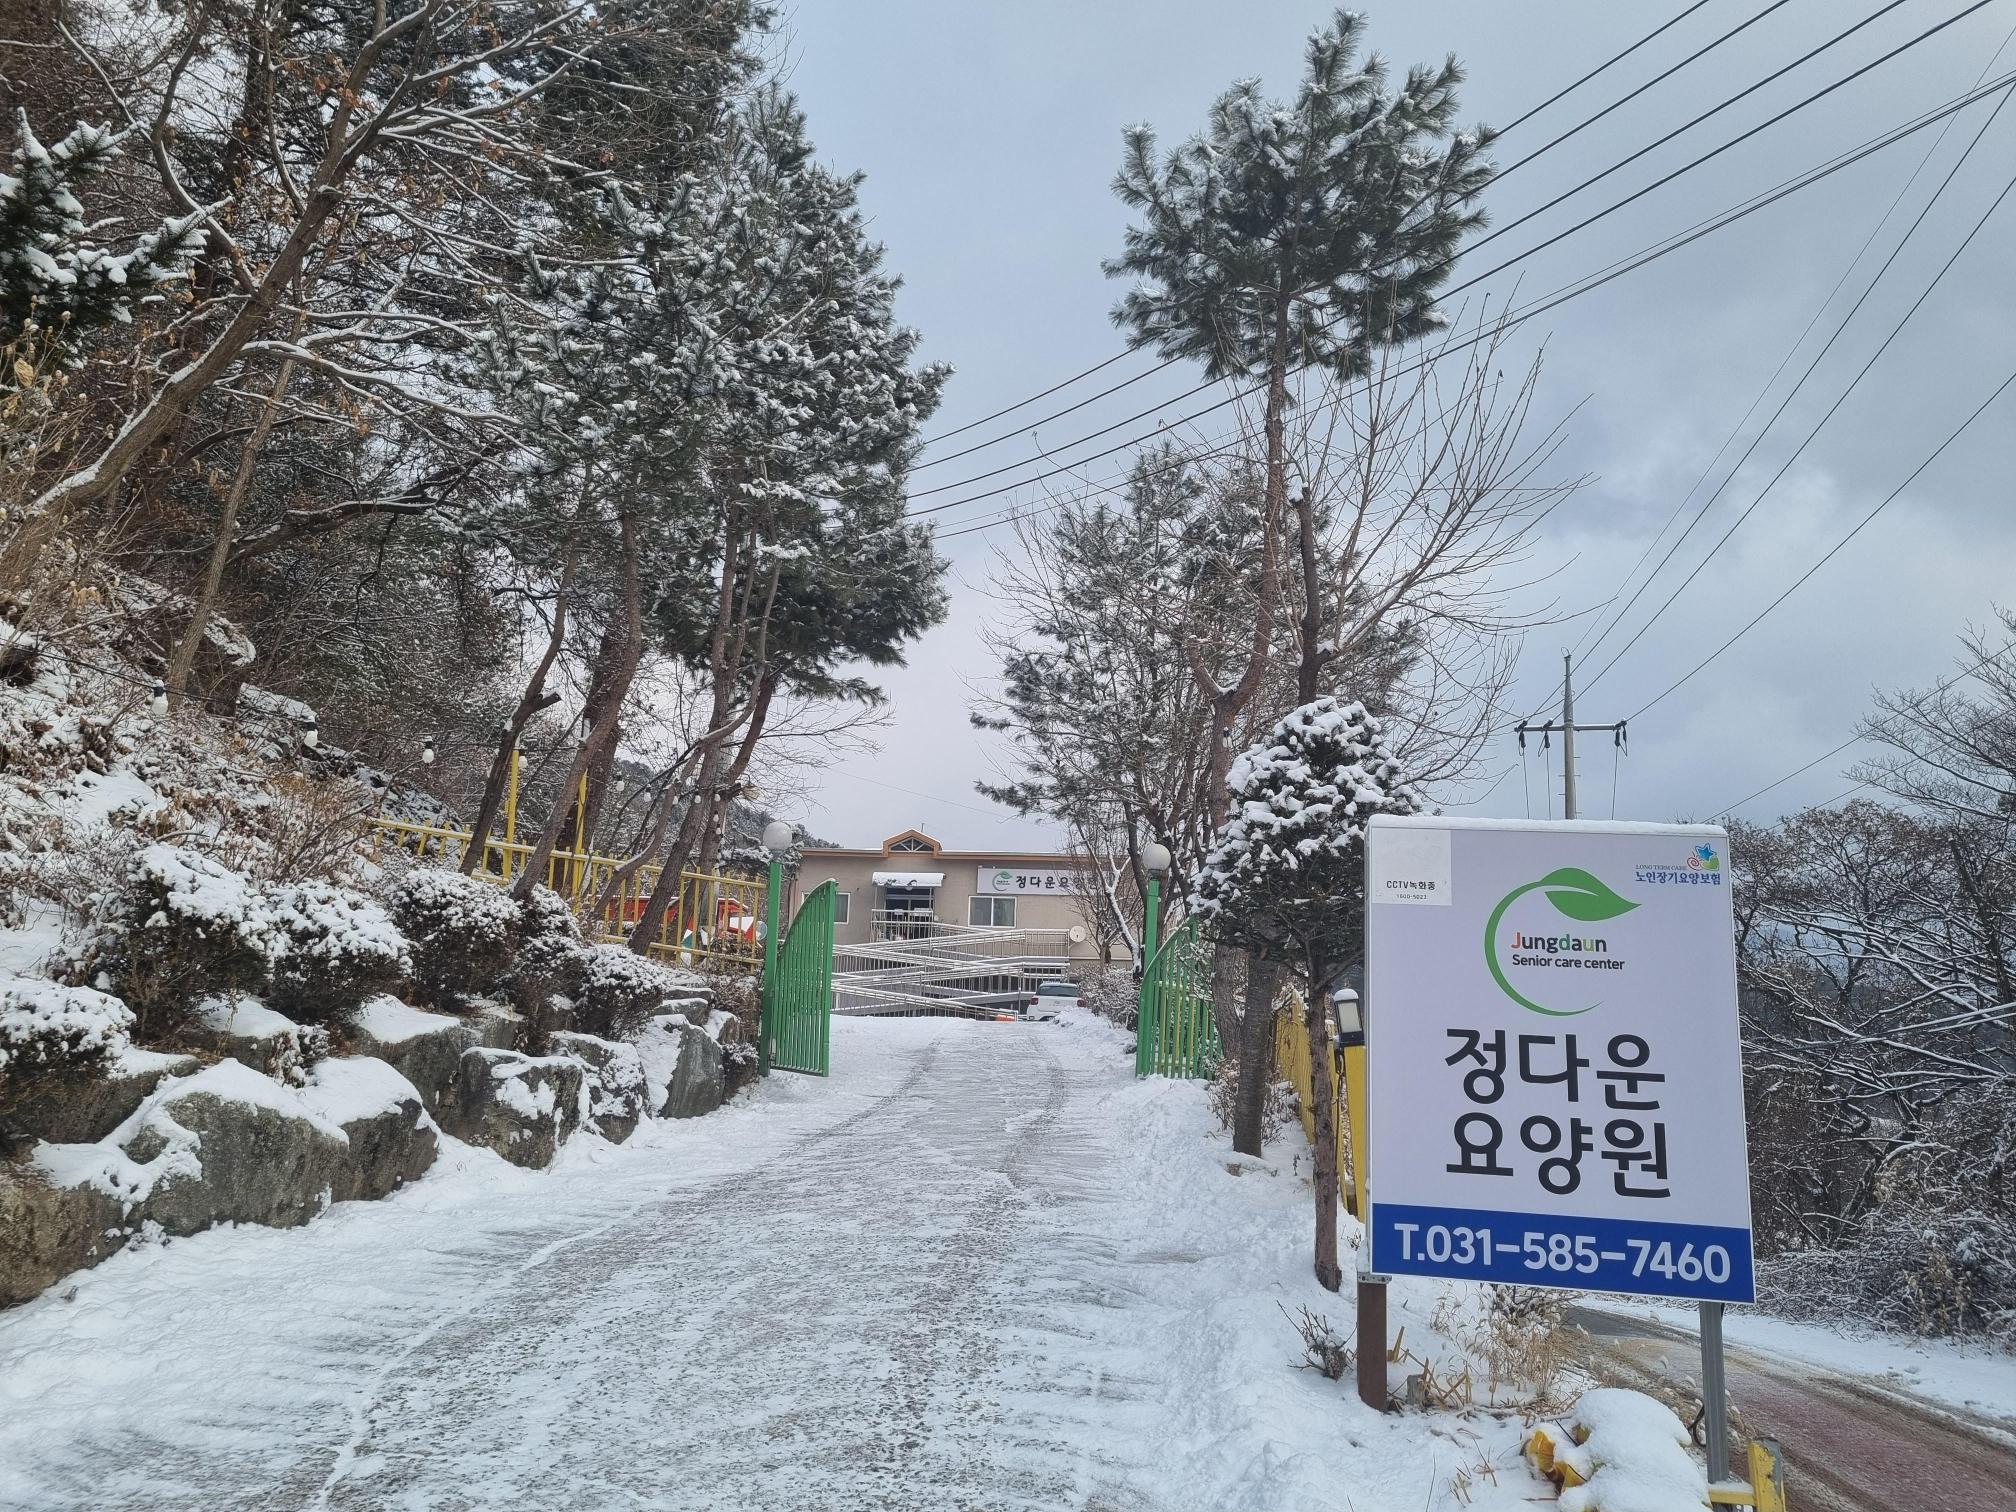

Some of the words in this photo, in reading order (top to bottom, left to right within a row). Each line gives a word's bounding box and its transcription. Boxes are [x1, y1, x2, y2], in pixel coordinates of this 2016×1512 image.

[1635, 871, 1721, 885] 노인장기요양보험
[1511, 932, 1607, 954] Jungdaun
[1512, 954, 1553, 967] Senior
[1554, 958, 1582, 968] care
[1584, 958, 1625, 970] center
[1444, 1028, 1666, 1111] 정다운
[1446, 1112, 1671, 1199] 요양원
[1394, 1223, 1731, 1284] T.031-585-7460
